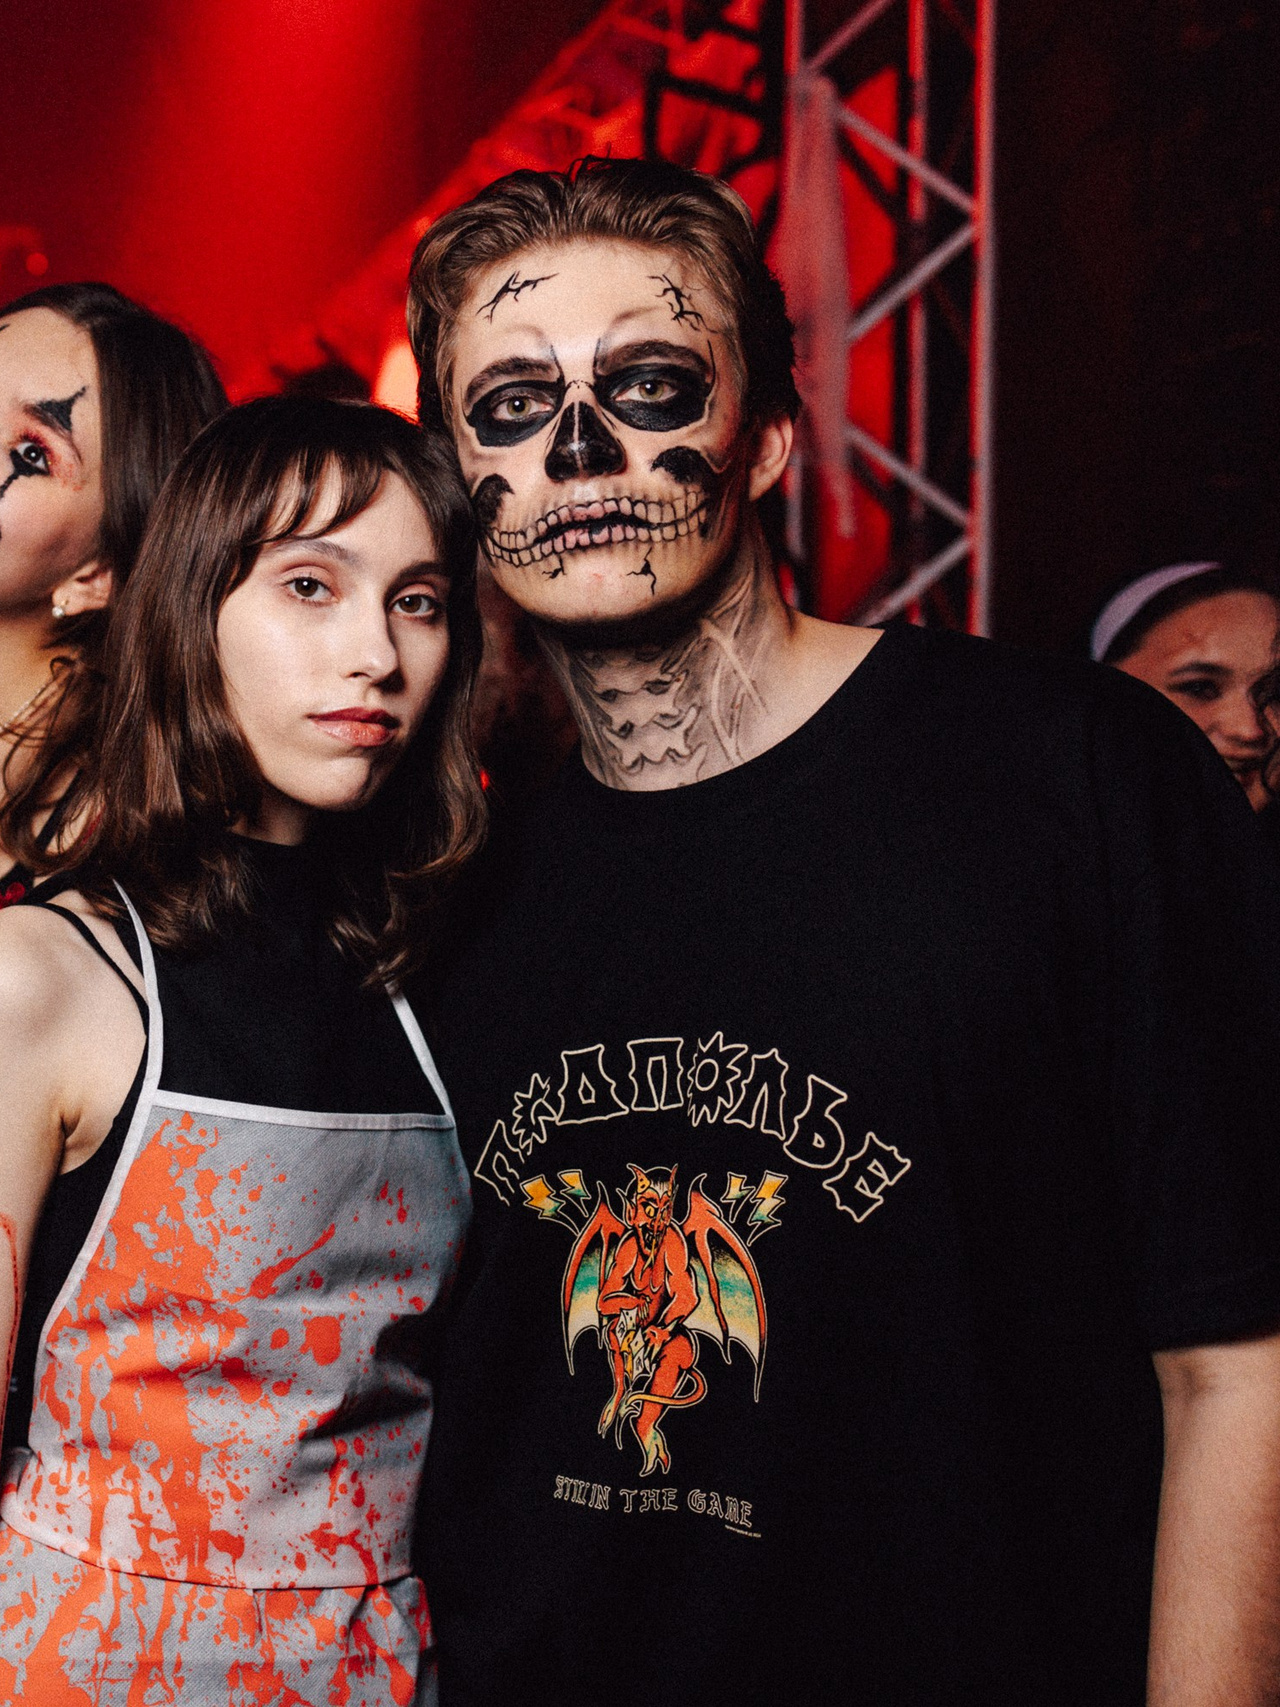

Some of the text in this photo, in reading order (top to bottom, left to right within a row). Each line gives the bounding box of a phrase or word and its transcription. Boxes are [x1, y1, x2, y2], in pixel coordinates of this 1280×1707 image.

[588, 1483, 611, 1510] IN
[619, 1488, 679, 1513] THE
[687, 1489, 753, 1528] GAME
